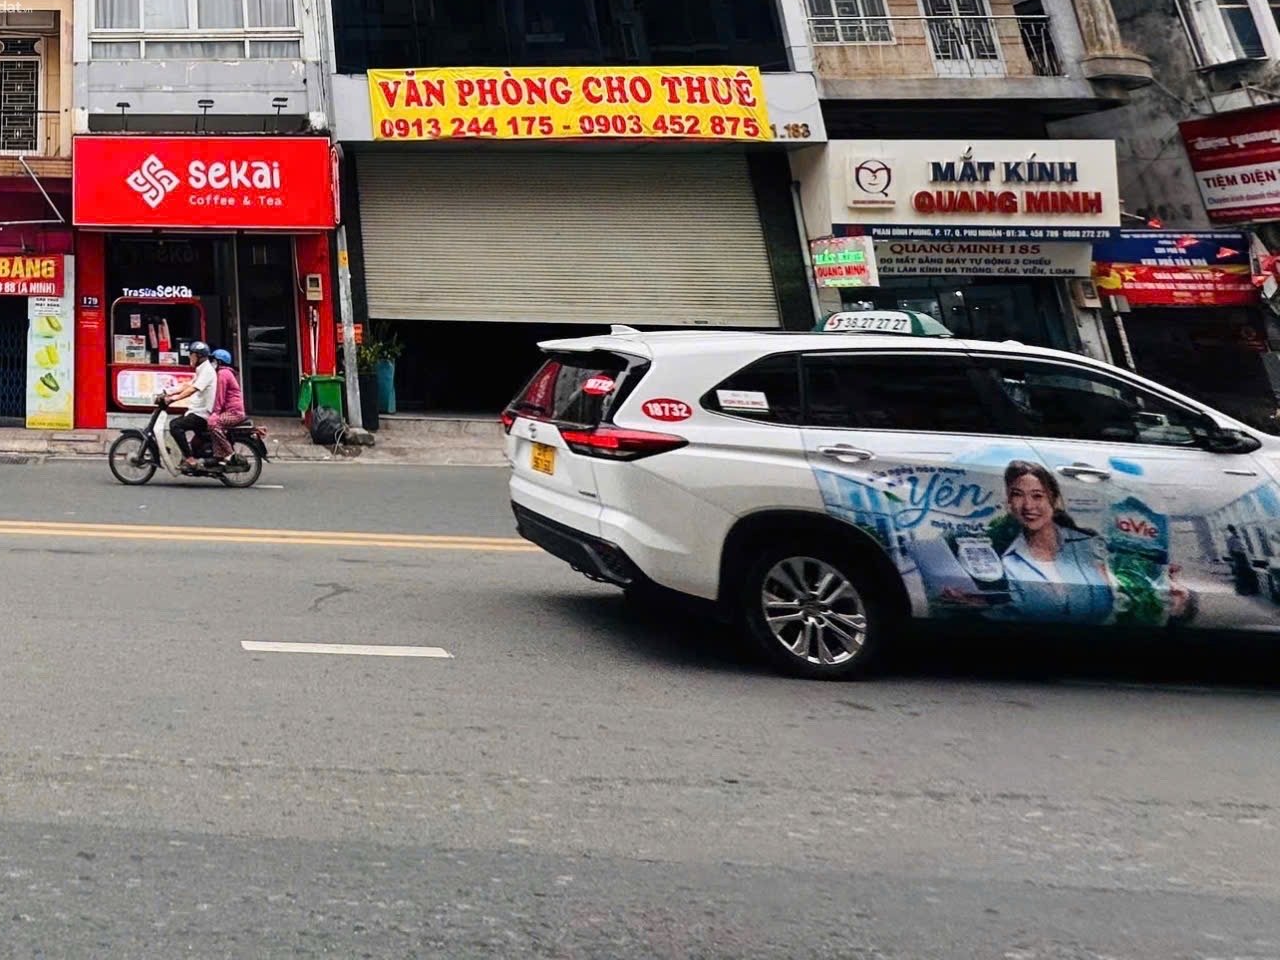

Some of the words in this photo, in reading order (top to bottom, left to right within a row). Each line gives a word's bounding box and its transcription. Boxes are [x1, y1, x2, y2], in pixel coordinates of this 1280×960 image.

[379, 71, 446, 108] VĂN
[457, 72, 572, 108] PHÒNG
[582, 76, 652, 105] CHO
[661, 71, 757, 107] THUÊ
[380, 118, 441, 138] 0913
[451, 117, 497, 137] 244
[506, 116, 553, 136] 175
[579, 115, 642, 135] 0903
[653, 116, 700, 135] 452
[711, 117, 760, 137] 875
[929, 146, 995, 183] MẮT
[1002, 153, 1078, 183] KÍNH
[1203, 173, 1238, 190] TIỆM
[1240, 169, 1277, 185] ĐIỆN
[189, 195, 235, 206] Coffee
[243, 196, 251, 205] &
[259, 196, 282, 206] Tea
[912, 190, 1018, 215] QUANG
[1024, 190, 1103, 214] MINH
[890, 244, 955, 254] QUANG
[958, 244, 1004, 254] MINH
[1010, 244, 1041, 254] 185
[817, 266, 844, 277] QUANG
[845, 264, 866, 275] MINH
[29, 282, 56, 295] NINH)
[645, 402, 689, 417] 18732
